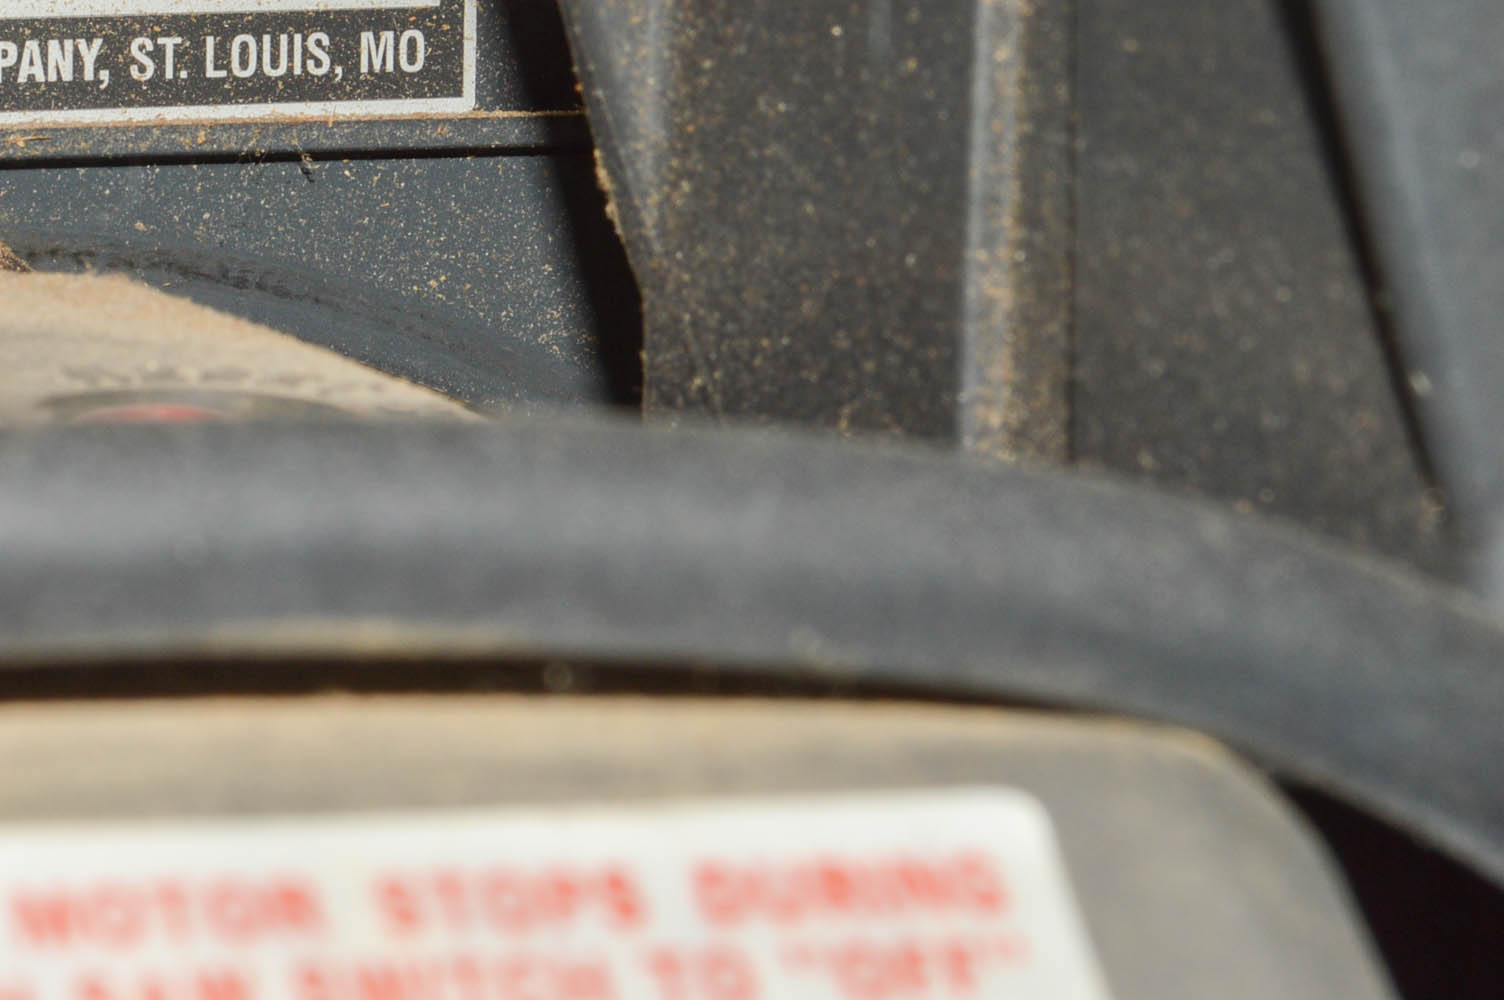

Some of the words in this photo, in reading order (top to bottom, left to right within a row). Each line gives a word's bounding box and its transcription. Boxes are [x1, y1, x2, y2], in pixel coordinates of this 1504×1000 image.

[130, 36, 188, 81] ST.
[204, 31, 344, 82] LOUIS,
[360, 28, 427, 74] MO
[8, 873, 330, 952] MOTOR
[370, 862, 650, 942] STOPS
